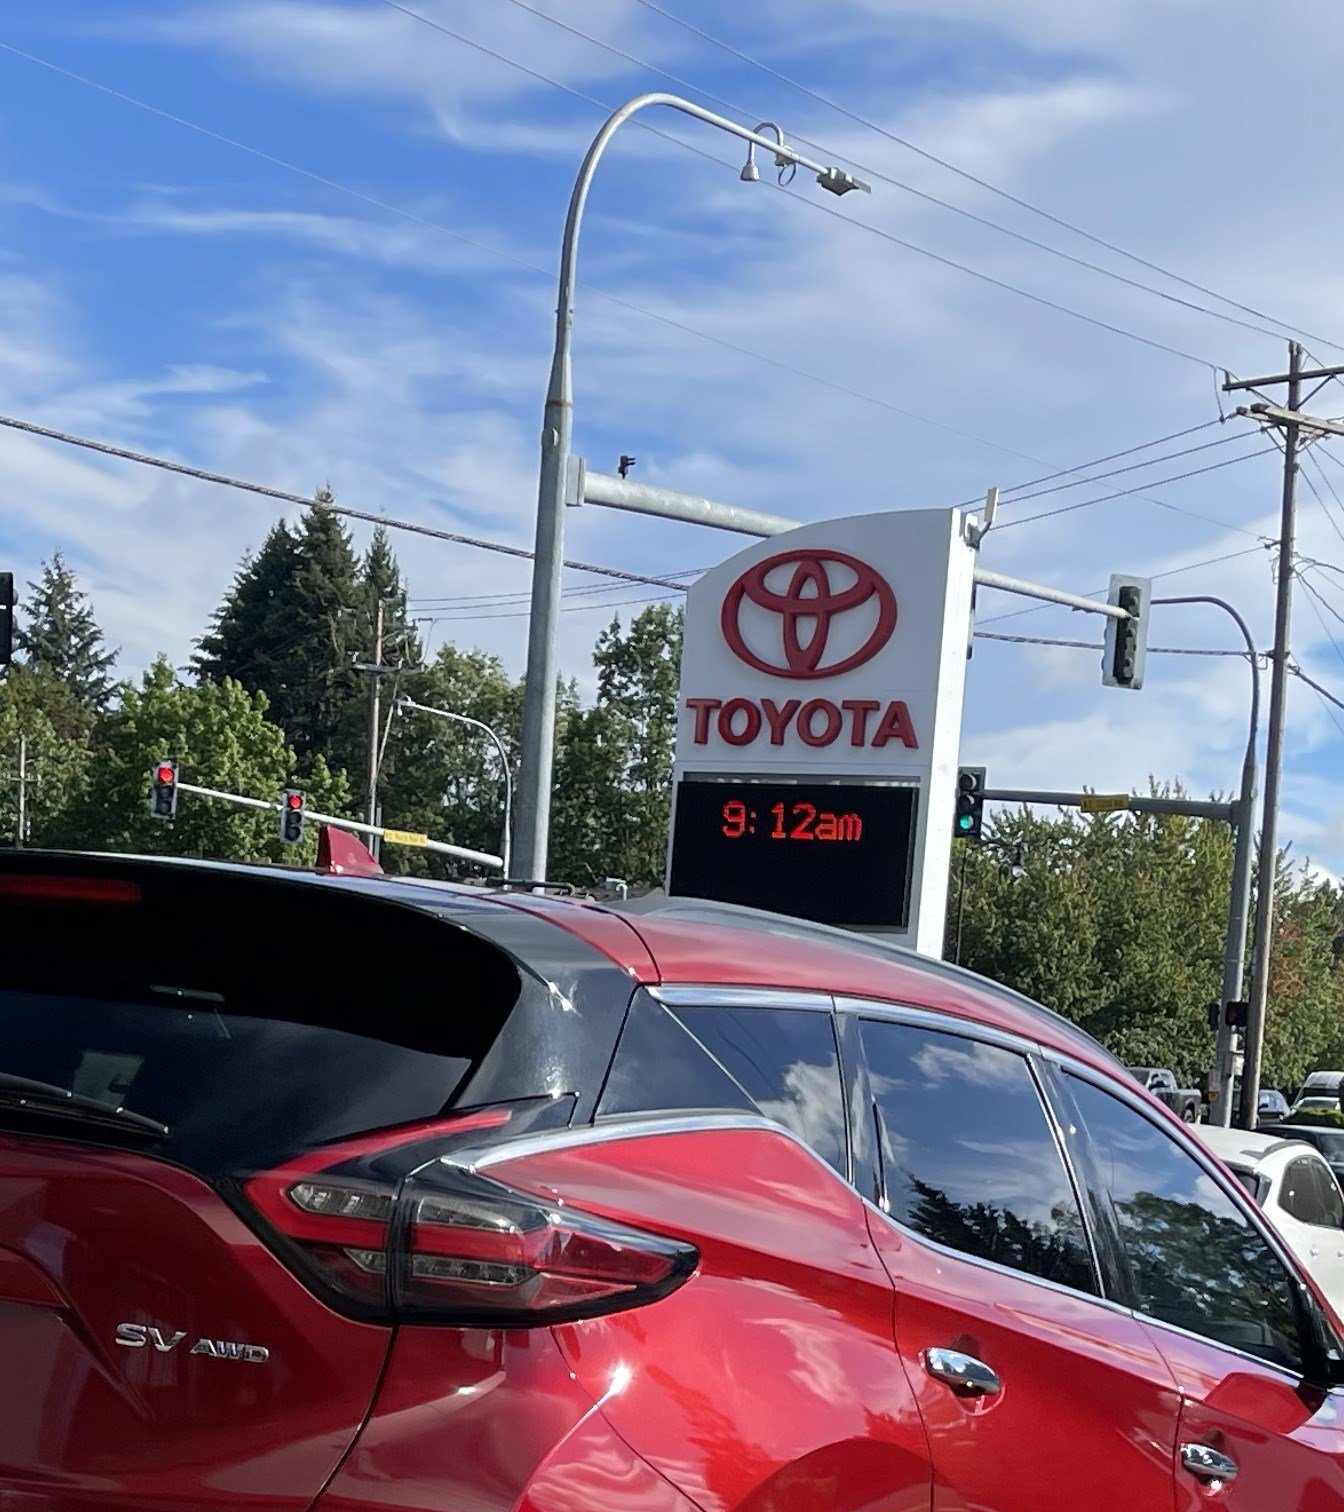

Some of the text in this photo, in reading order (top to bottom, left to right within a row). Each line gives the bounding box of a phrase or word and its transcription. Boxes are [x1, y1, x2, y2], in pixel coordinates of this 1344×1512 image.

[686, 697, 919, 749] TOYOTA
[115, 1322, 270, 1363] SV AWD
